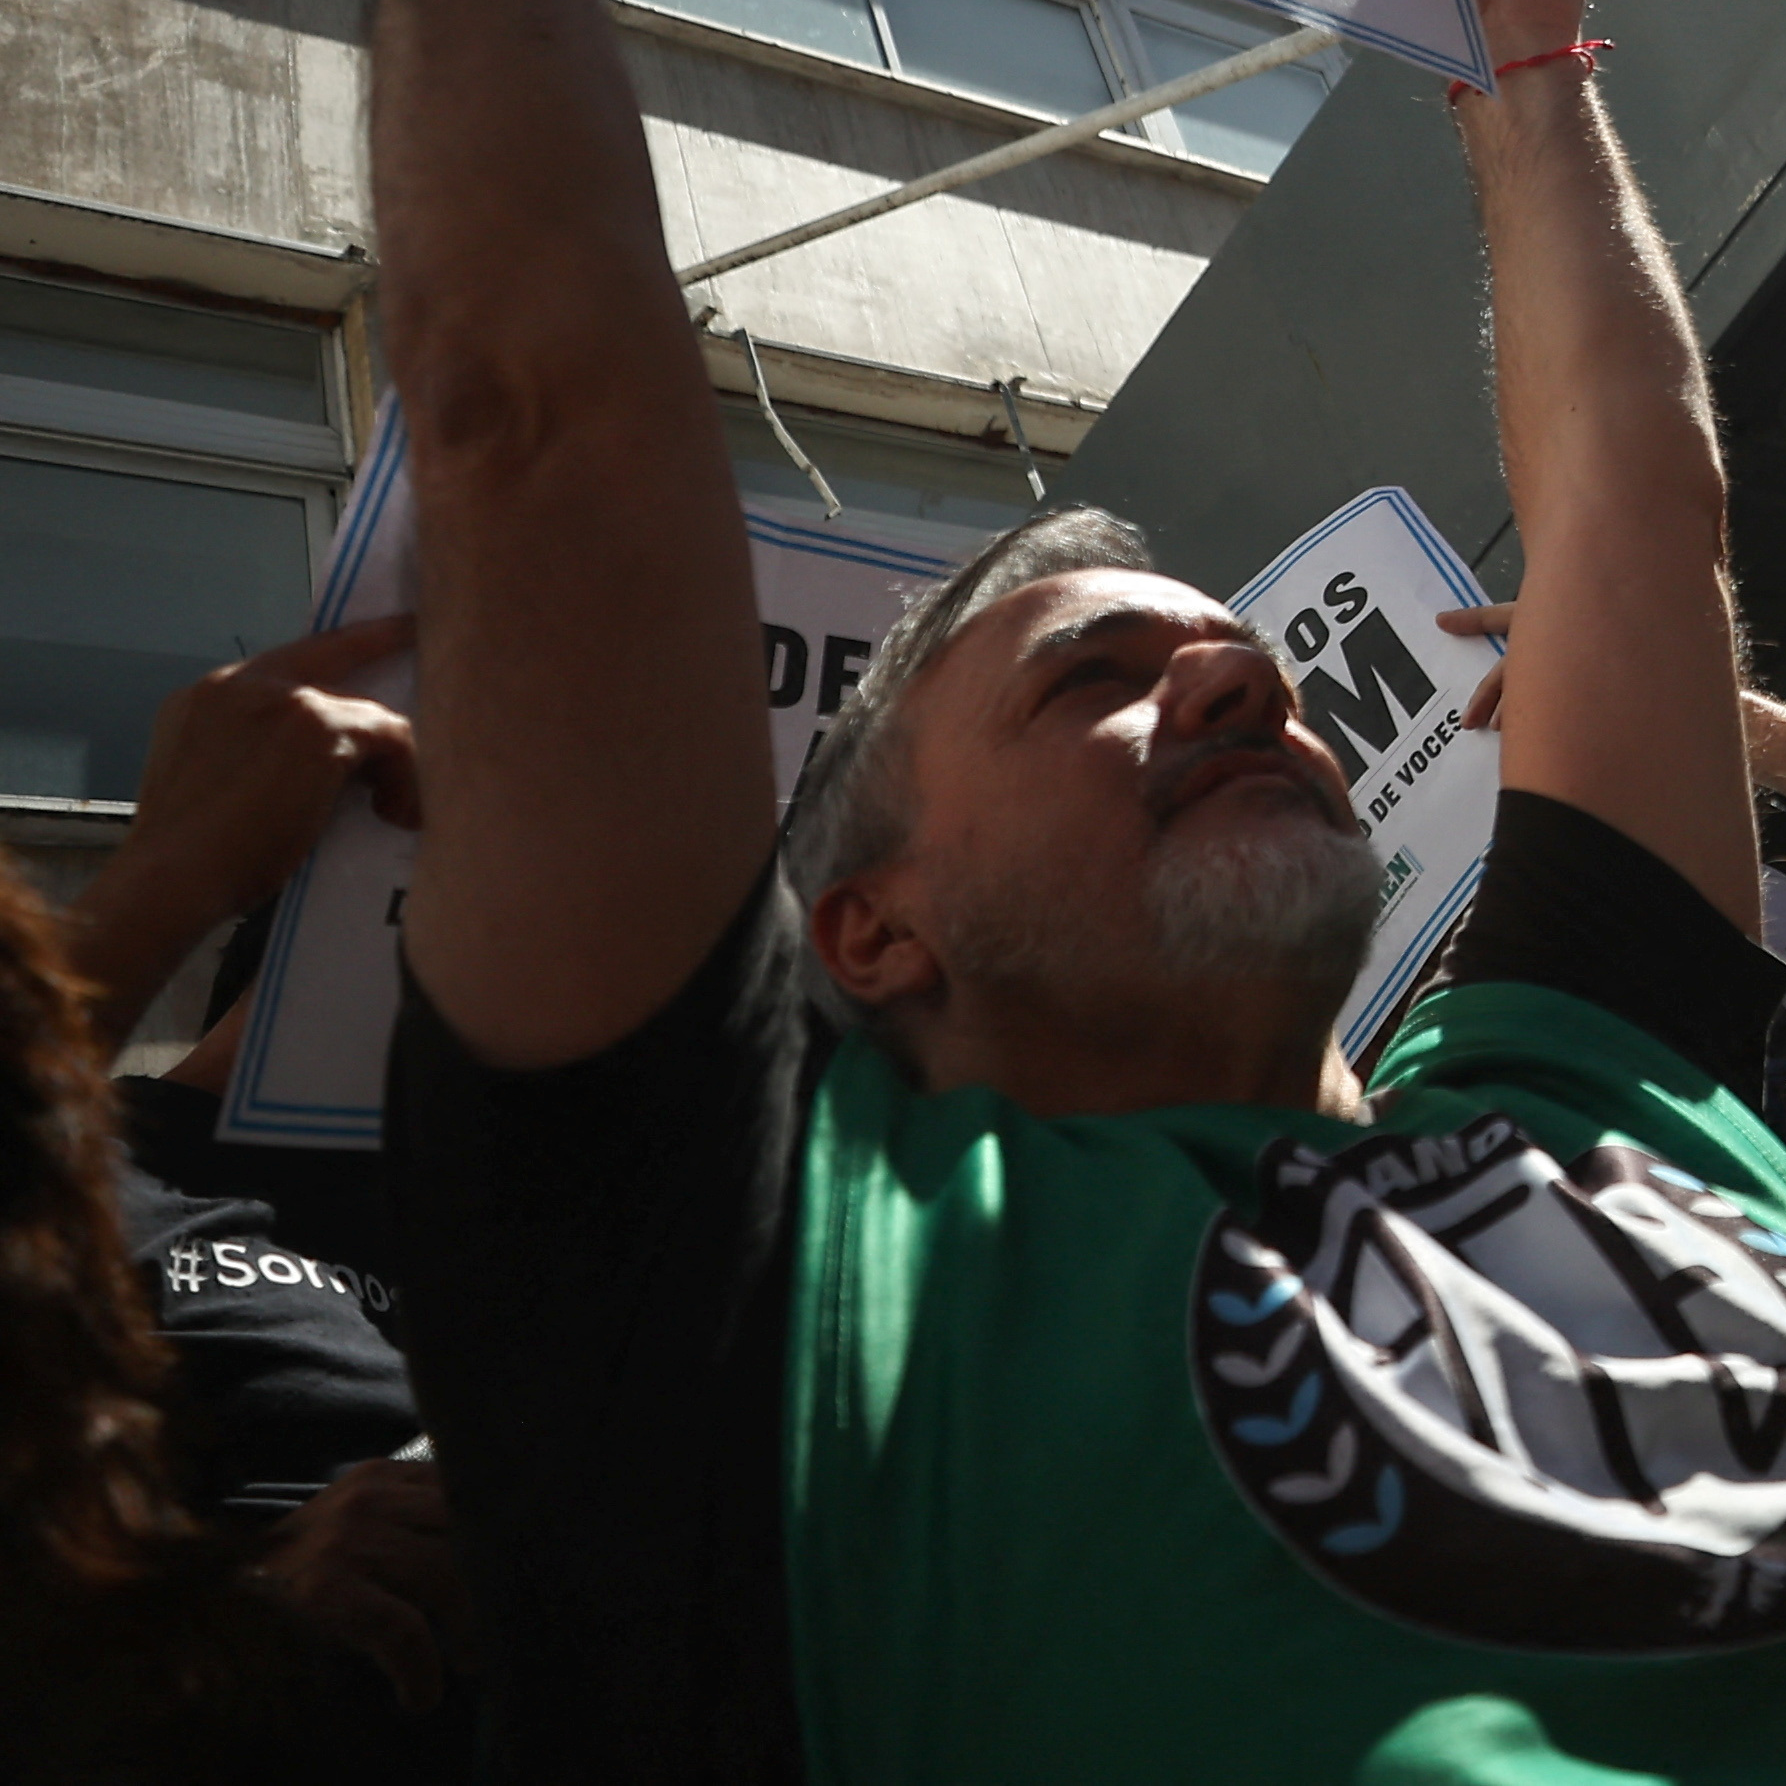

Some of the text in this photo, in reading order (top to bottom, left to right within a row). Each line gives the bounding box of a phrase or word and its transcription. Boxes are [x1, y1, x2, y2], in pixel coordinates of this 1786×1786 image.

[1368, 783, 1401, 823] DE
[1395, 709, 1462, 787] VOCES
[166, 1236, 401, 1313] #Somo
